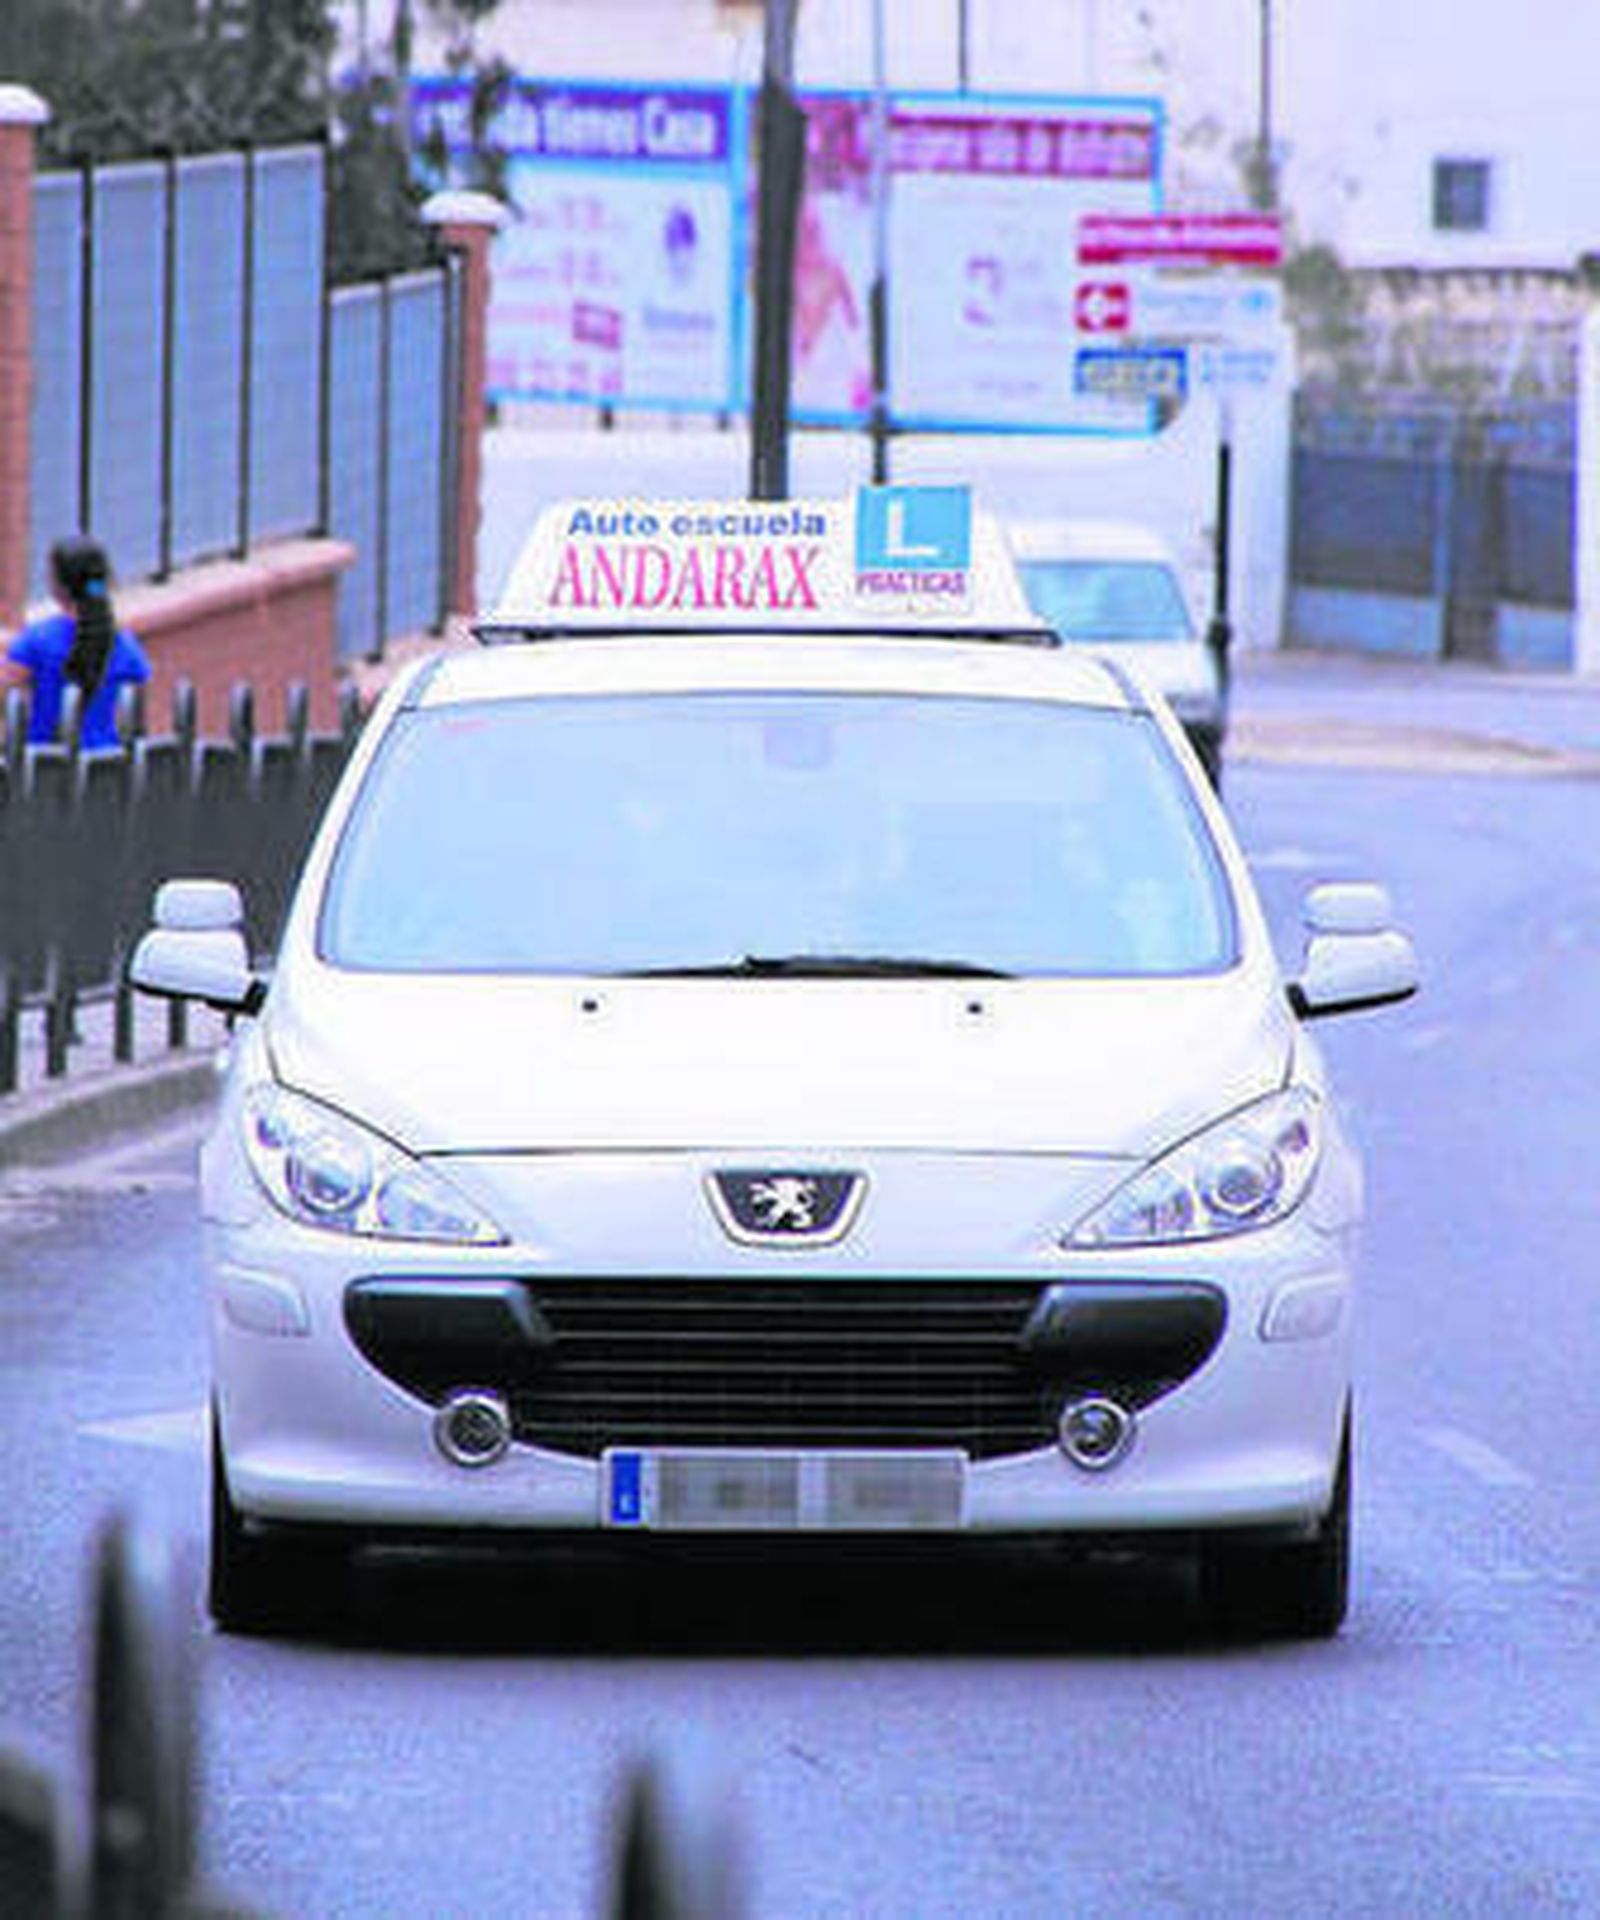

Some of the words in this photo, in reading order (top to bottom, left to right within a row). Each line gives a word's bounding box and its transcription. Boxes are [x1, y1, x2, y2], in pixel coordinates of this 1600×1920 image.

[568, 509, 659, 536] Auto
[671, 508, 826, 536] escuela
[886, 499, 940, 557] L
[549, 542, 821, 610] ANDARAX
